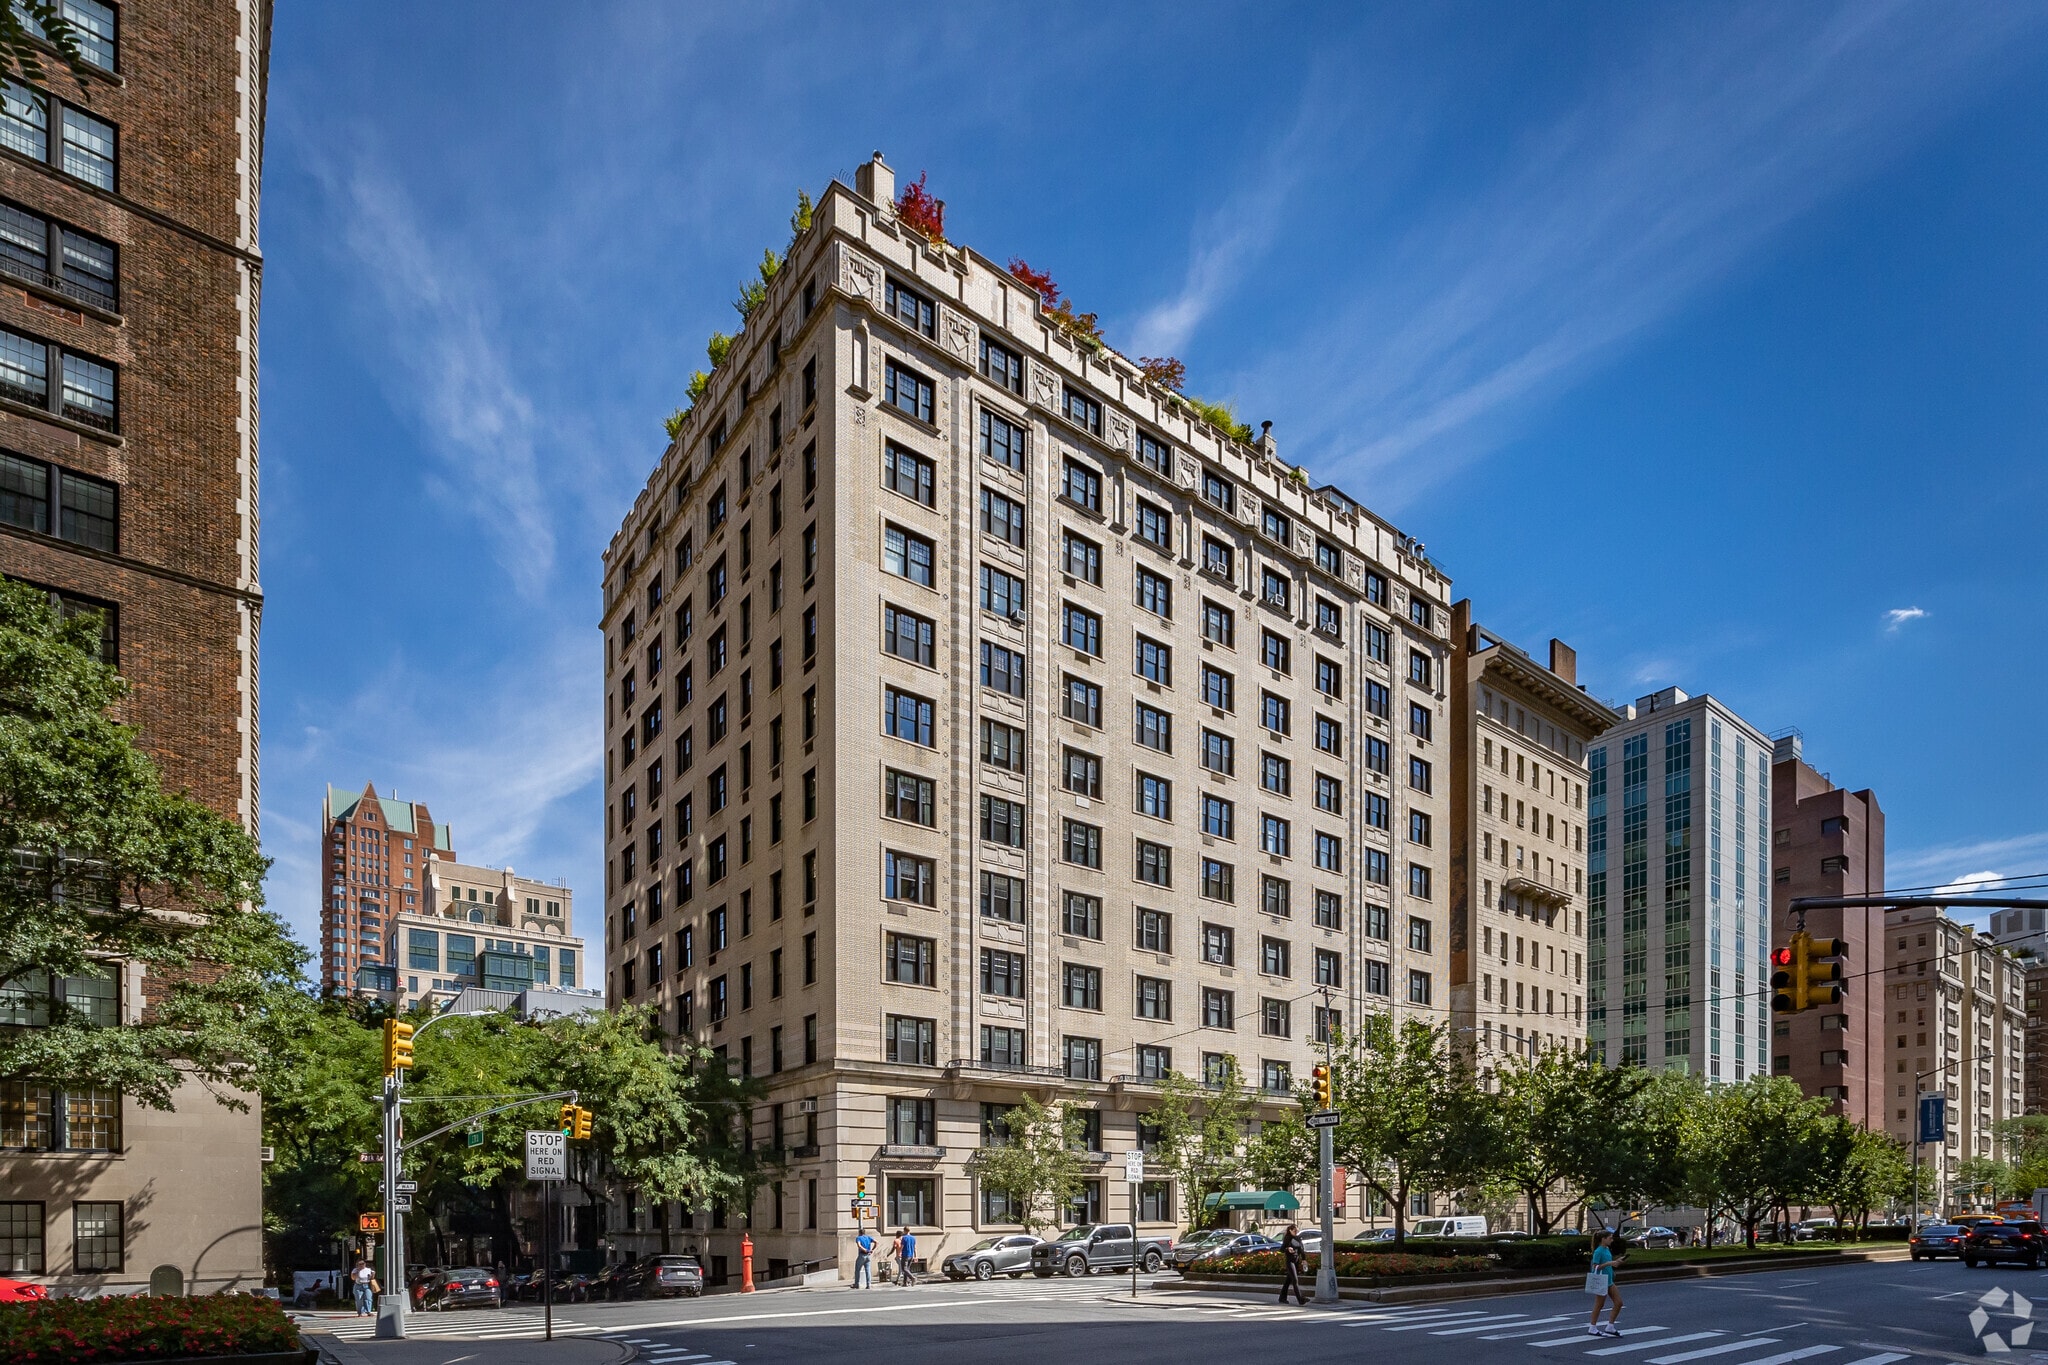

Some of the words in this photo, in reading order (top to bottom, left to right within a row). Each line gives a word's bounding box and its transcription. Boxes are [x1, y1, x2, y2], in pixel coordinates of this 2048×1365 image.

[530, 1134, 562, 1146] STOP
[530, 1147, 549, 1156] HERE
[552, 1147, 562, 1156] ON
[1127, 1152, 1142, 1160] STOP
[537, 1157, 555, 1165] RED
[530, 1166, 562, 1175] SIGNAL
